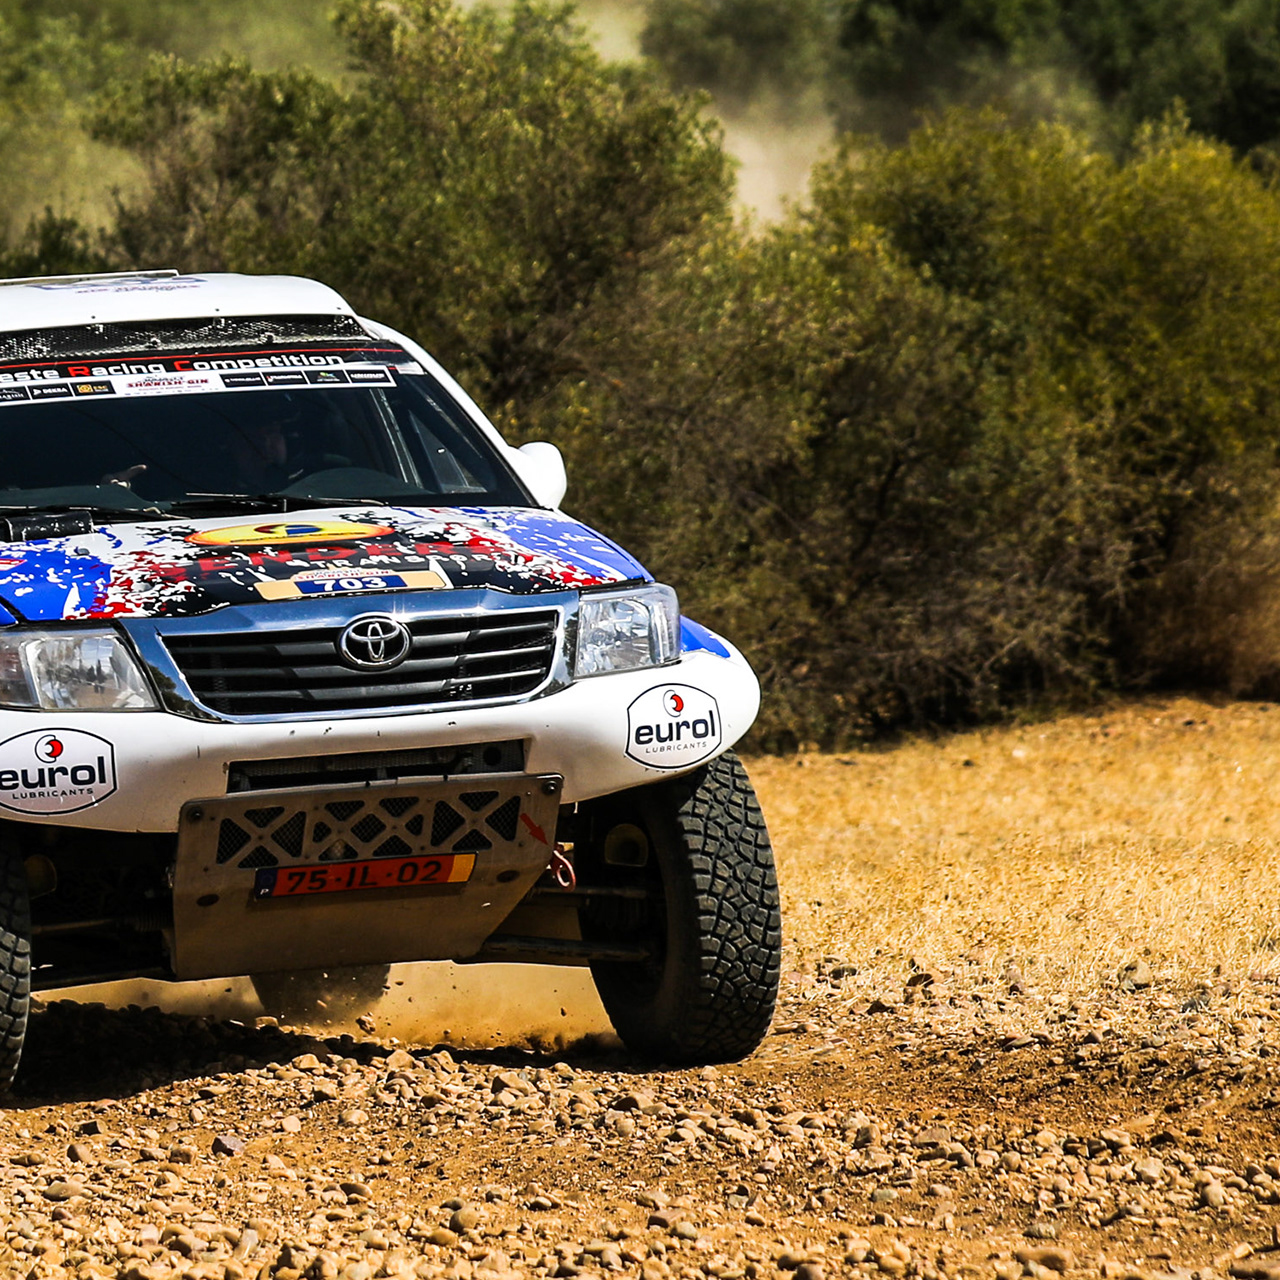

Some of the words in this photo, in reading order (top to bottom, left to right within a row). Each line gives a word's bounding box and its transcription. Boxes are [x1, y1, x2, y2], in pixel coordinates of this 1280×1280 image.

[67, 363, 165, 378] Racing
[174, 354, 345, 371] Competition
[314, 577, 387, 592] 703
[635, 710, 716, 745] eurol
[646, 742, 707, 754] LUBRICANTS
[12, 788, 94, 800] LUBRICANTS
